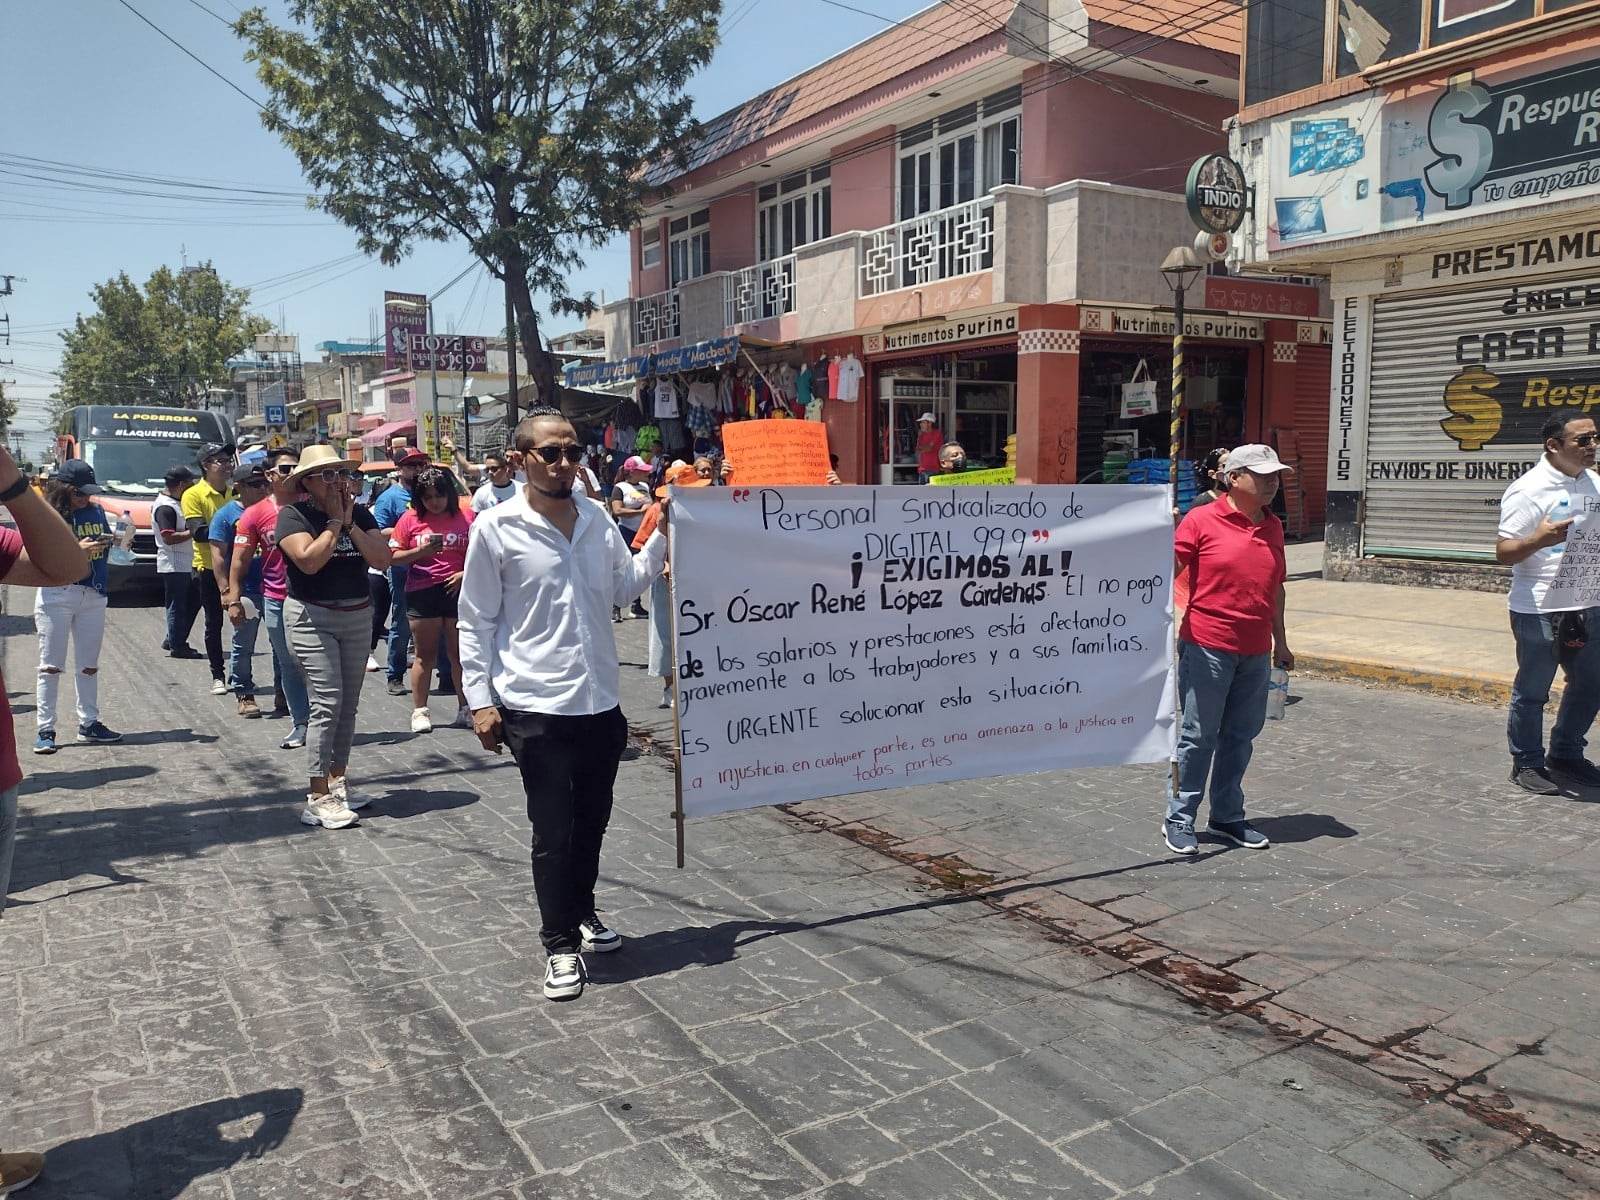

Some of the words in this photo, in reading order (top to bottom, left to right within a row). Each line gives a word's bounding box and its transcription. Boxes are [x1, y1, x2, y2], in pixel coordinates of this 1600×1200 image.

[1496, 87, 1600, 135] Respue
[1204, 189, 1241, 208] INDIO
[1483, 183, 1505, 202] Tu
[1509, 162, 1600, 199] empeño
[1431, 229, 1600, 279] PRESTAMO
[885, 327, 954, 349] Nutrimentos
[957, 315, 1016, 338] Purina
[1114, 315, 1200, 336] Nutrimenos
[1204, 321, 1258, 339] Purina
[1456, 326, 1564, 365] CASA
[1337, 296, 1358, 481] ELECTRODOMESTICOS
[1522, 376, 1600, 413] Resp
[112, 412, 129, 420] LA
[132, 412, 198, 423] PODEROSA
[115, 429, 201, 440] #LAQUETEGUSTA
[1370, 461, 1431, 480] ENVIOS
[1435, 461, 1459, 480] DE
[902, 489, 1047, 523] Sindicalizado
[1062, 491, 1086, 519] de
[864, 531, 959, 561] DIGITAL
[679, 599, 718, 637] Sr.
[726, 588, 800, 623] Óscar
[811, 582, 866, 614] René
[880, 583, 943, 615] López
[1065, 574, 1084, 597] El
[1098, 578, 1120, 596] no
[1127, 575, 1163, 604] pago
[679, 650, 704, 680] de
[717, 645, 745, 672] los
[756, 637, 837, 667] salarios
[849, 639, 859, 658] y
[864, 623, 975, 659] prestaciones
[988, 613, 1025, 637] está
[1040, 608, 1127, 632] afectando
[680, 668, 787, 718] gravemente
[803, 672, 815, 685] a
[828, 663, 855, 683] los
[868, 649, 977, 682] trabajadores
[989, 649, 998, 666] y
[1009, 648, 1020, 660] a
[1032, 645, 1060, 659] sus
[1071, 633, 1149, 655] familias.
[681, 729, 710, 756] Es
[727, 706, 820, 745] URGENTE
[839, 699, 926, 725] solucionar
[940, 686, 972, 709] esta
[988, 676, 1083, 703] situación.
[792, 760, 810, 773] en
[815, 750, 866, 771] cualquier
[873, 735, 915, 764] parte,
[922, 737, 935, 748] es
[943, 731, 968, 745] una
[977, 720, 1034, 739] amenaza
[1044, 722, 1052, 732] a
[1058, 717, 1068, 730] la
[1075, 714, 1117, 734] justicia
[1121, 714, 1134, 725] en
[853, 763, 894, 782] todas
[905, 752, 953, 777] partes
